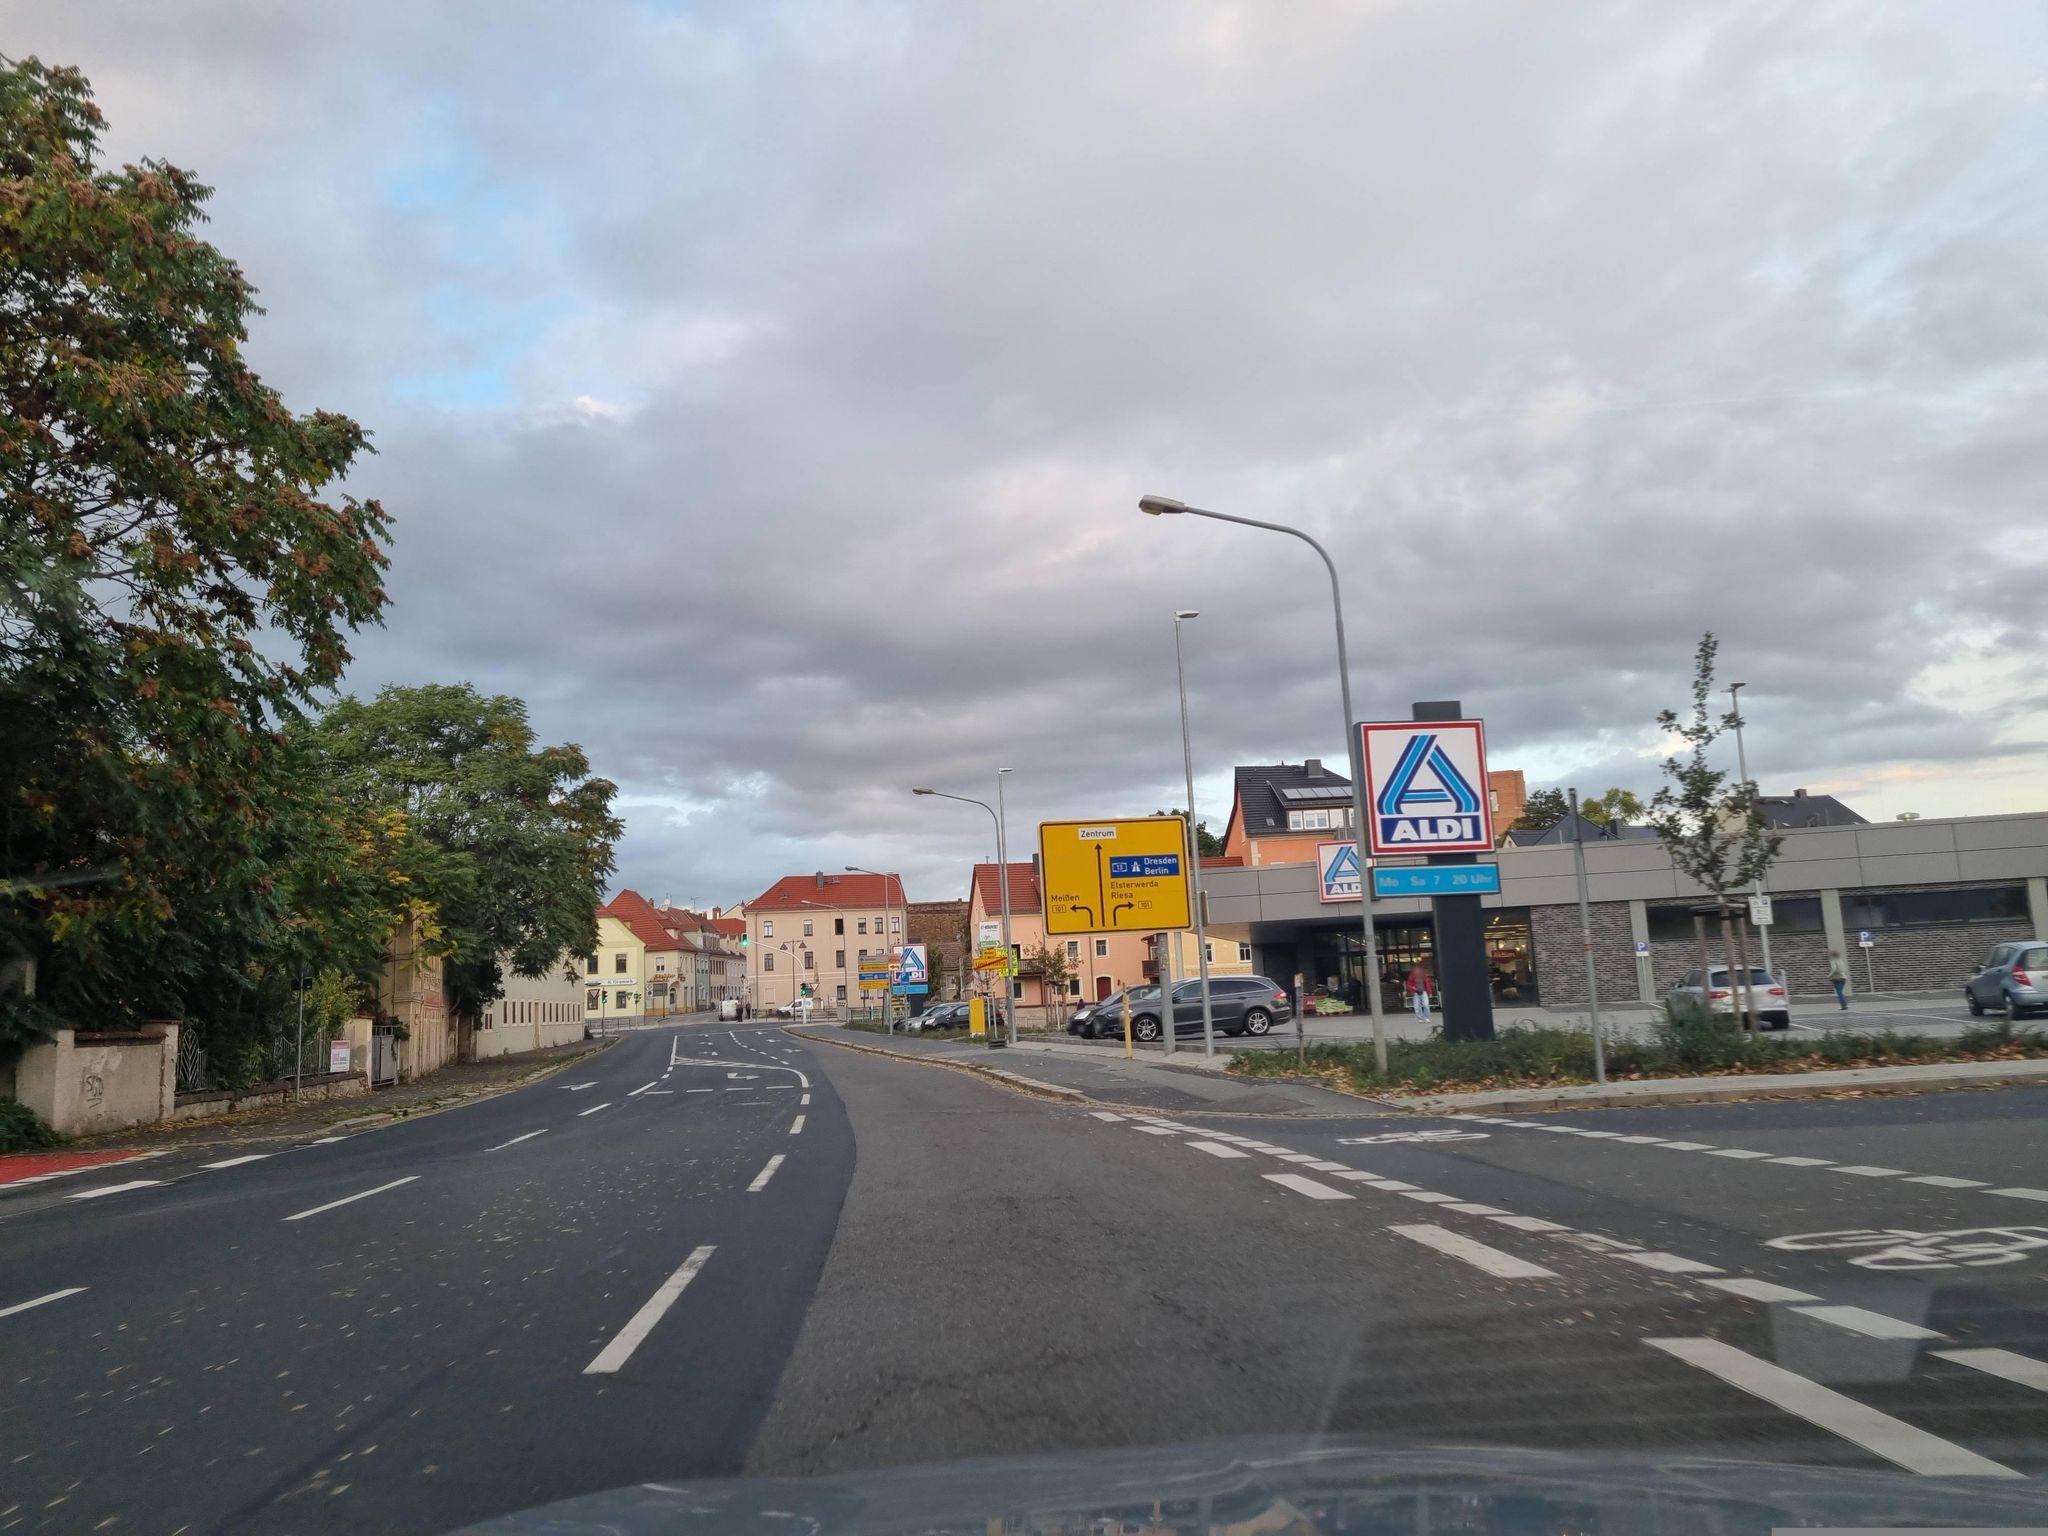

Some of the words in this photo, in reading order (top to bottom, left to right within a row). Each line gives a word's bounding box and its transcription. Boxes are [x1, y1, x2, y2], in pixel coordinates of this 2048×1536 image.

[1081, 830, 1115, 838] Zentrum
[1391, 818, 1474, 842] ALDI
[1144, 857, 1177, 865] Dresden
[1145, 867, 1169, 875] Berlin
[1378, 877, 1399, 887] Mo
[1410, 876, 1426, 886] Sa
[1433, 875, 1441, 885] 7
[1452, 874, 1468, 885] 20
[1470, 874, 1493, 884] Uhr
[1110, 881, 1159, 889] Elsterwerda
[1330, 883, 1361, 894] ALD
[1051, 894, 1080, 902] Meißen
[1111, 892, 1133, 900] Riesa
[1860, 931, 1869, 941] P
[1637, 942, 1646, 950] P
